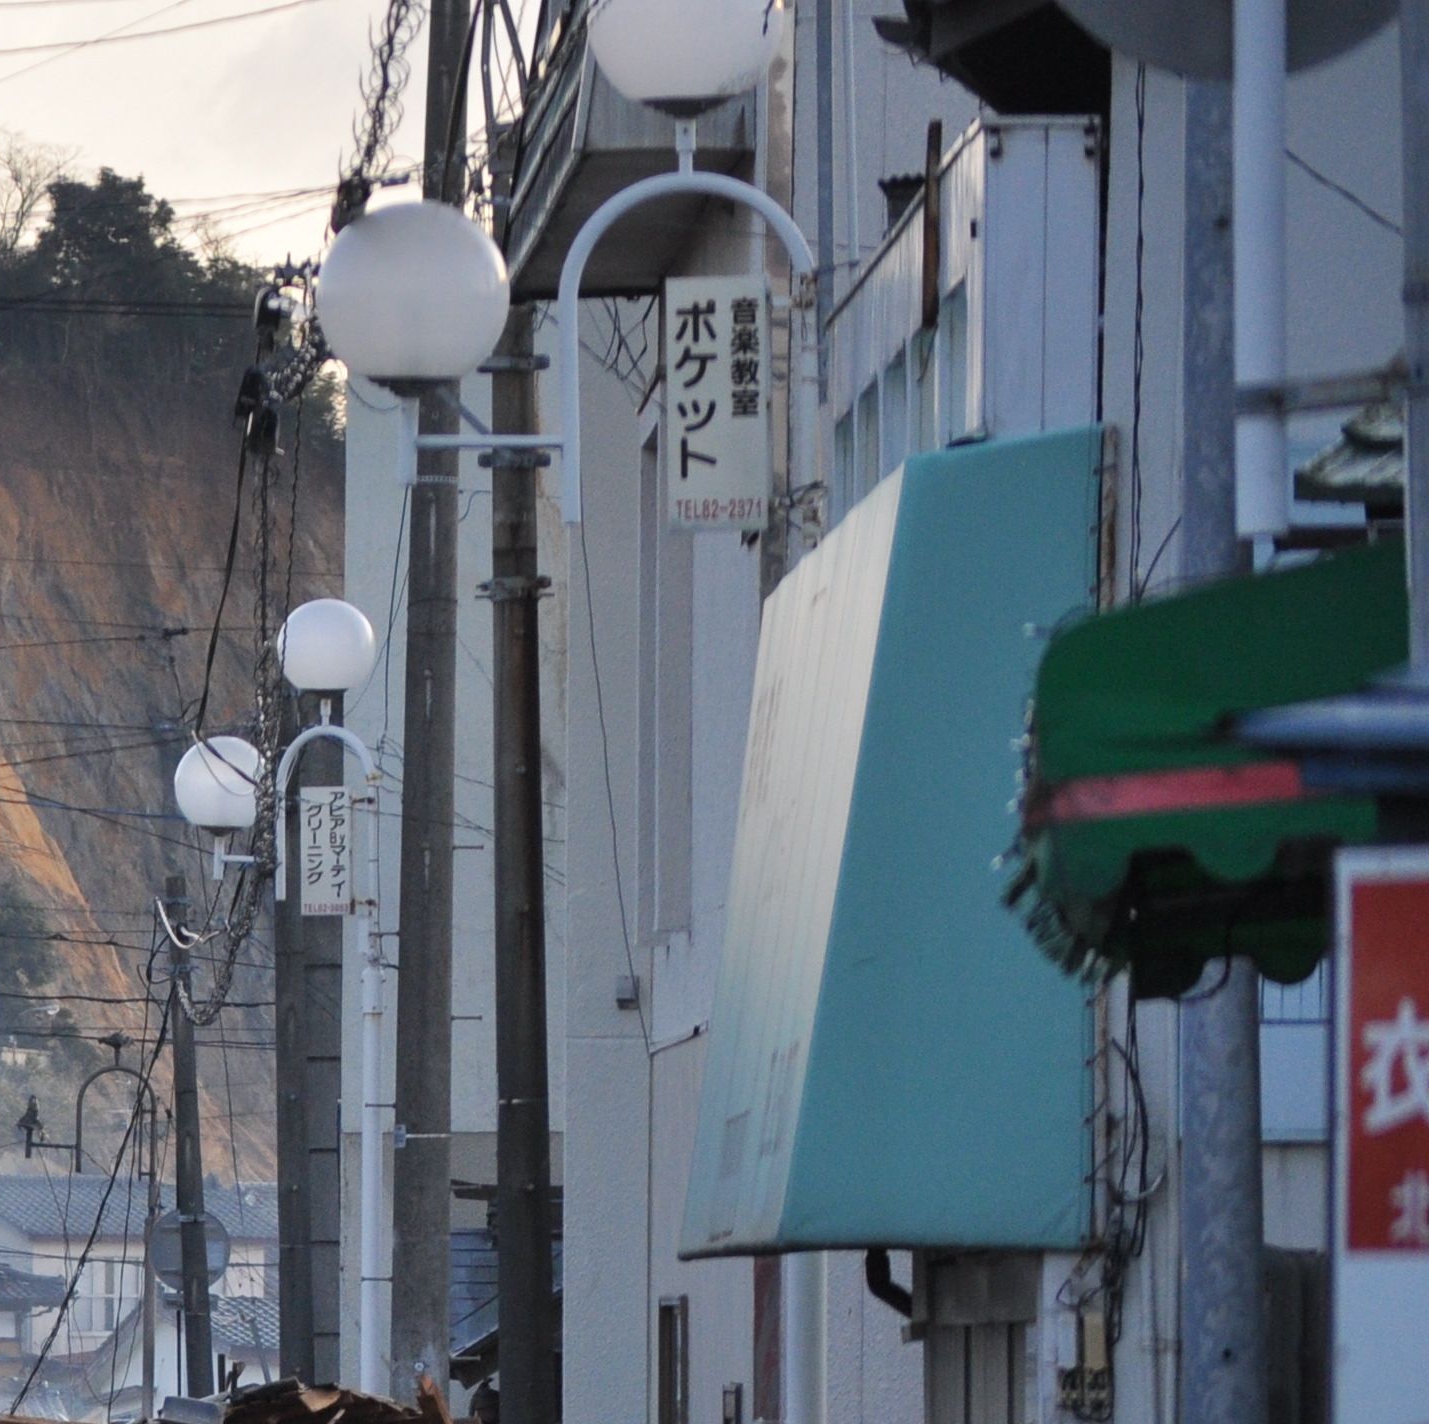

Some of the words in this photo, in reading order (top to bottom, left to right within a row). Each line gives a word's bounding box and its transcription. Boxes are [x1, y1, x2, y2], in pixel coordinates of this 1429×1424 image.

[675, 299, 717, 479] ポケット
[730, 297, 760, 418] 音楽教室
[676, 497, 762, 522] TEL82-2371
[306, 803, 324, 886] クリーニング
